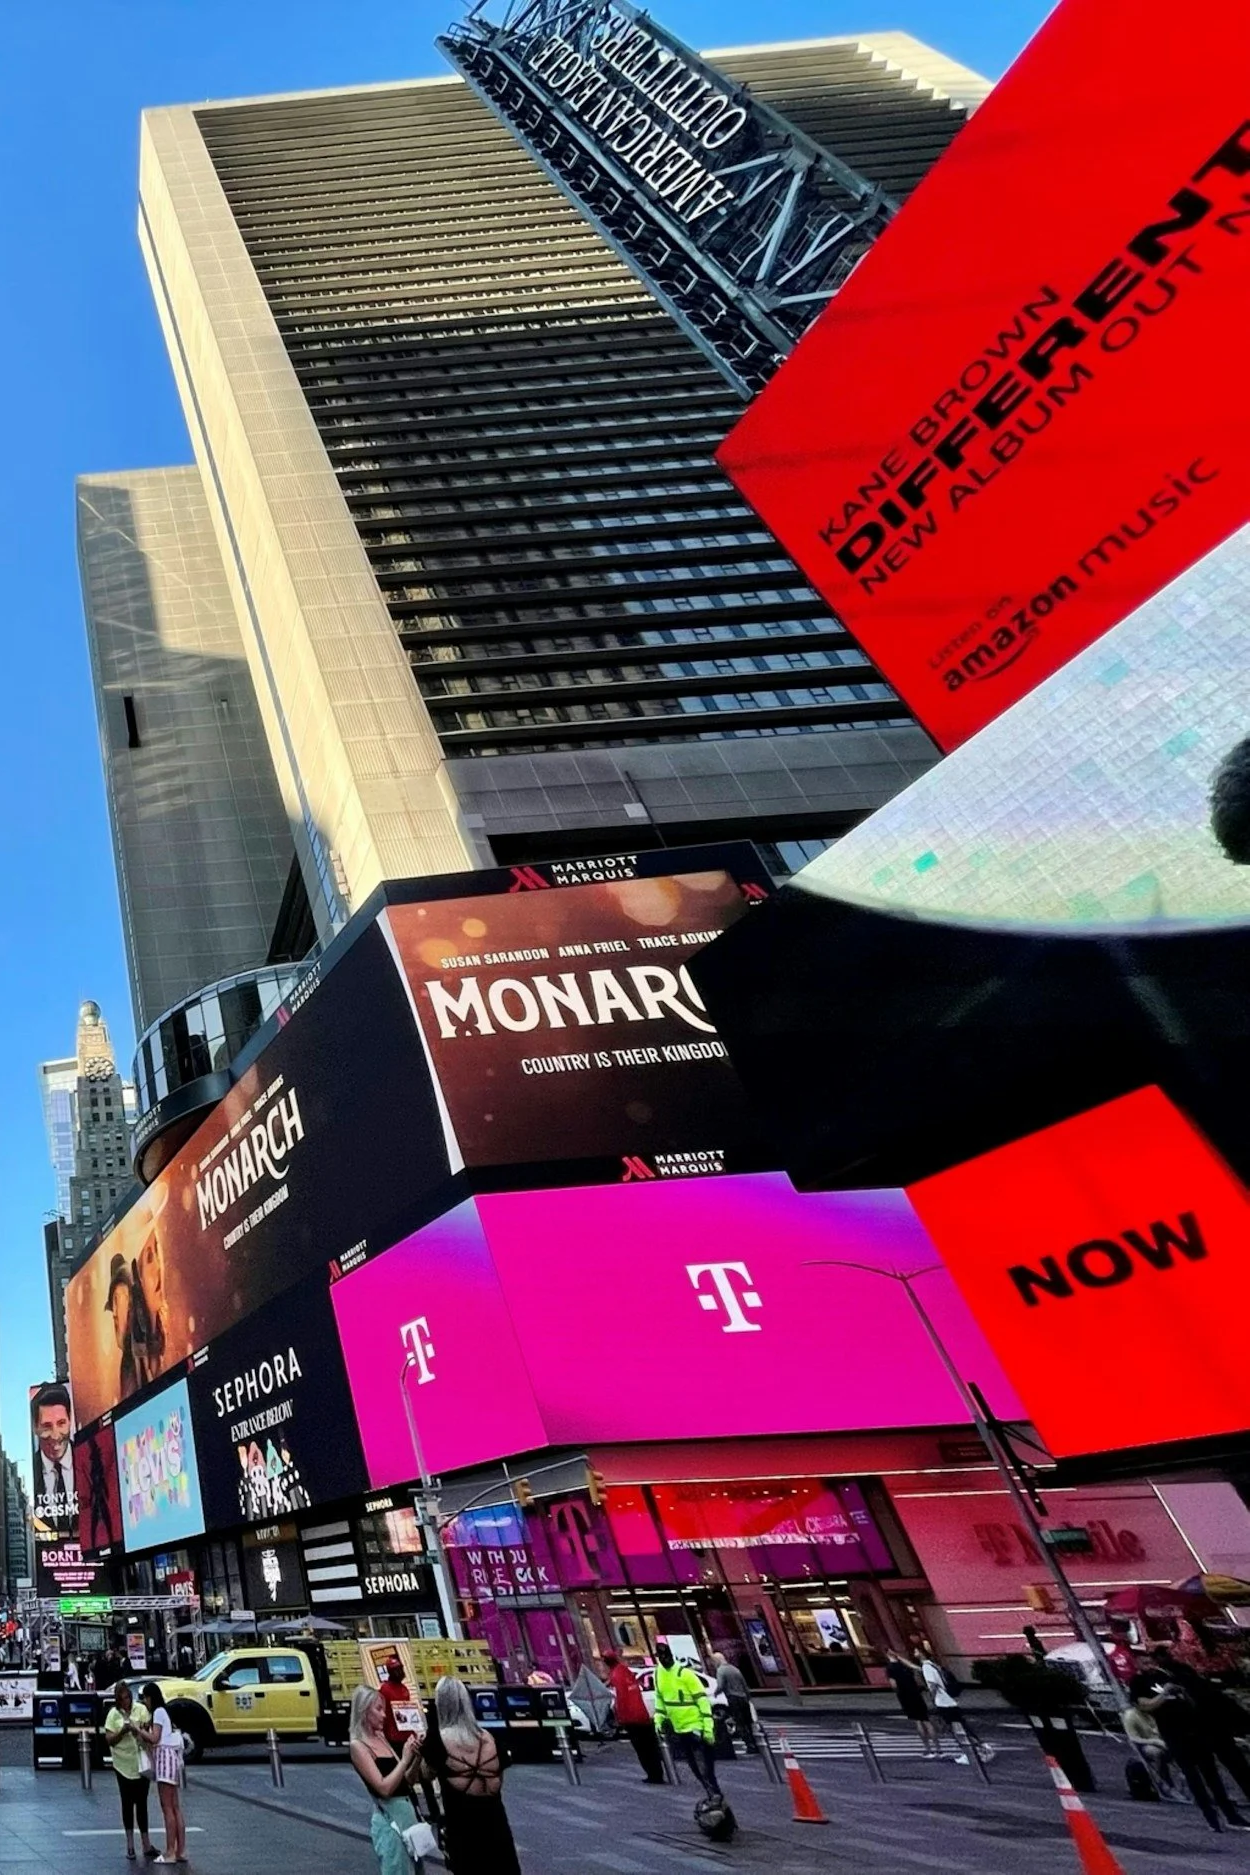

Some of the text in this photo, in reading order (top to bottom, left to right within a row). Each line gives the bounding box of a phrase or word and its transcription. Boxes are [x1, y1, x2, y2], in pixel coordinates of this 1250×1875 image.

[591, 14, 748, 150] OUTFITTERS
[528, 33, 736, 224] AMERICAN EAGLE
[835, 118, 1250, 576] DIFFERENT
[817, 286, 1063, 547] KANE BROWN
[857, 243, 1205, 597] NEW ALBUM OUT
[939, 456, 1221, 692] amazon music
[550, 855, 638, 874] MARRIOTT
[556, 867, 636, 886] MARQUIS
[441, 955, 481, 969] SUSAN
[484, 947, 550, 965] SARANDON
[558, 942, 593, 958] ANNA
[594, 940, 630, 955] FRIEL
[637, 934, 680, 950] TRACE
[289, 961, 322, 1004] MARRIOTT
[291, 977, 321, 1014] MARQUIS
[424, 963, 718, 1039] MONAR
[521, 1040, 728, 1075] COUNTRY IS THEIR KINGDO
[195, 1086, 305, 1232] MONARCH
[655, 1150, 725, 1165] MARRIOTT
[659, 1162, 724, 1176] MARQUIS
[340, 1239, 367, 1263] MARRIOTT
[342, 1251, 367, 1273] MARQUIS
[1006, 1210, 1209, 1308] NOW
[213, 1346, 303, 1418] SEPHORA
[230, 1399, 293, 1443] ENTRANCE BELOW
[37, 1492, 65, 1505] TONY
[44, 1504, 65, 1518] CBS
[365, 1497, 394, 1513] SEPHORA
[41, 1550, 74, 1562] BORN
[365, 1573, 420, 1595] SEPHORA
